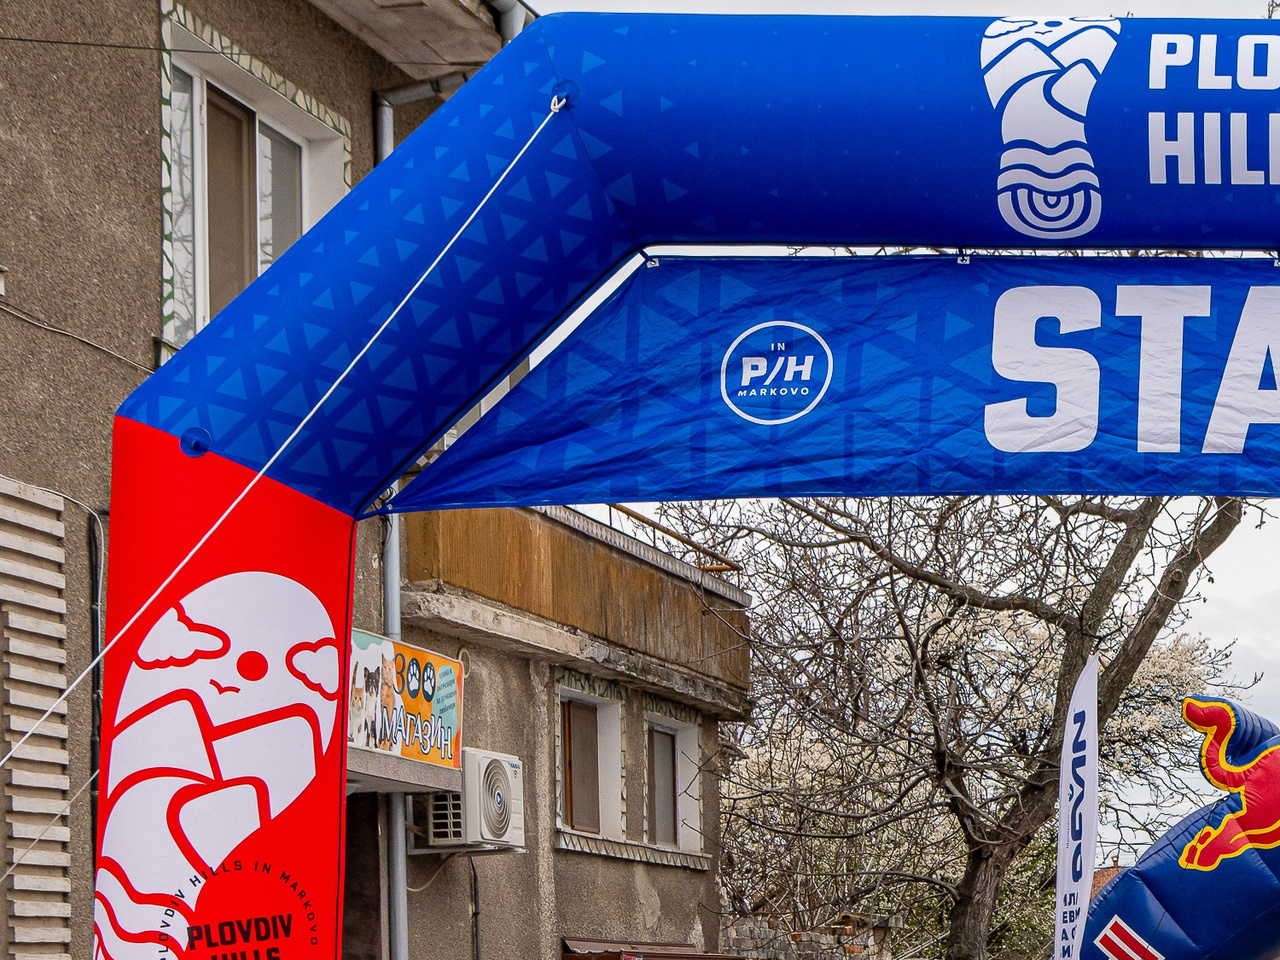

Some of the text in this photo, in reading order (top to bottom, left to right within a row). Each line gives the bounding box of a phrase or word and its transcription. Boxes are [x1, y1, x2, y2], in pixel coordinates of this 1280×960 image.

[770, 342, 786, 351] IN
[740, 355, 815, 387] P/H
[737, 387, 810, 397] MARKOVO
[381, 705, 453, 760] МАГАЗИН
[188, 860, 243, 888] HILLS
[253, 861, 272, 875] IN
[279, 870, 318, 946] MARKOVO
[186, 913, 293, 951] PLOVDIV
